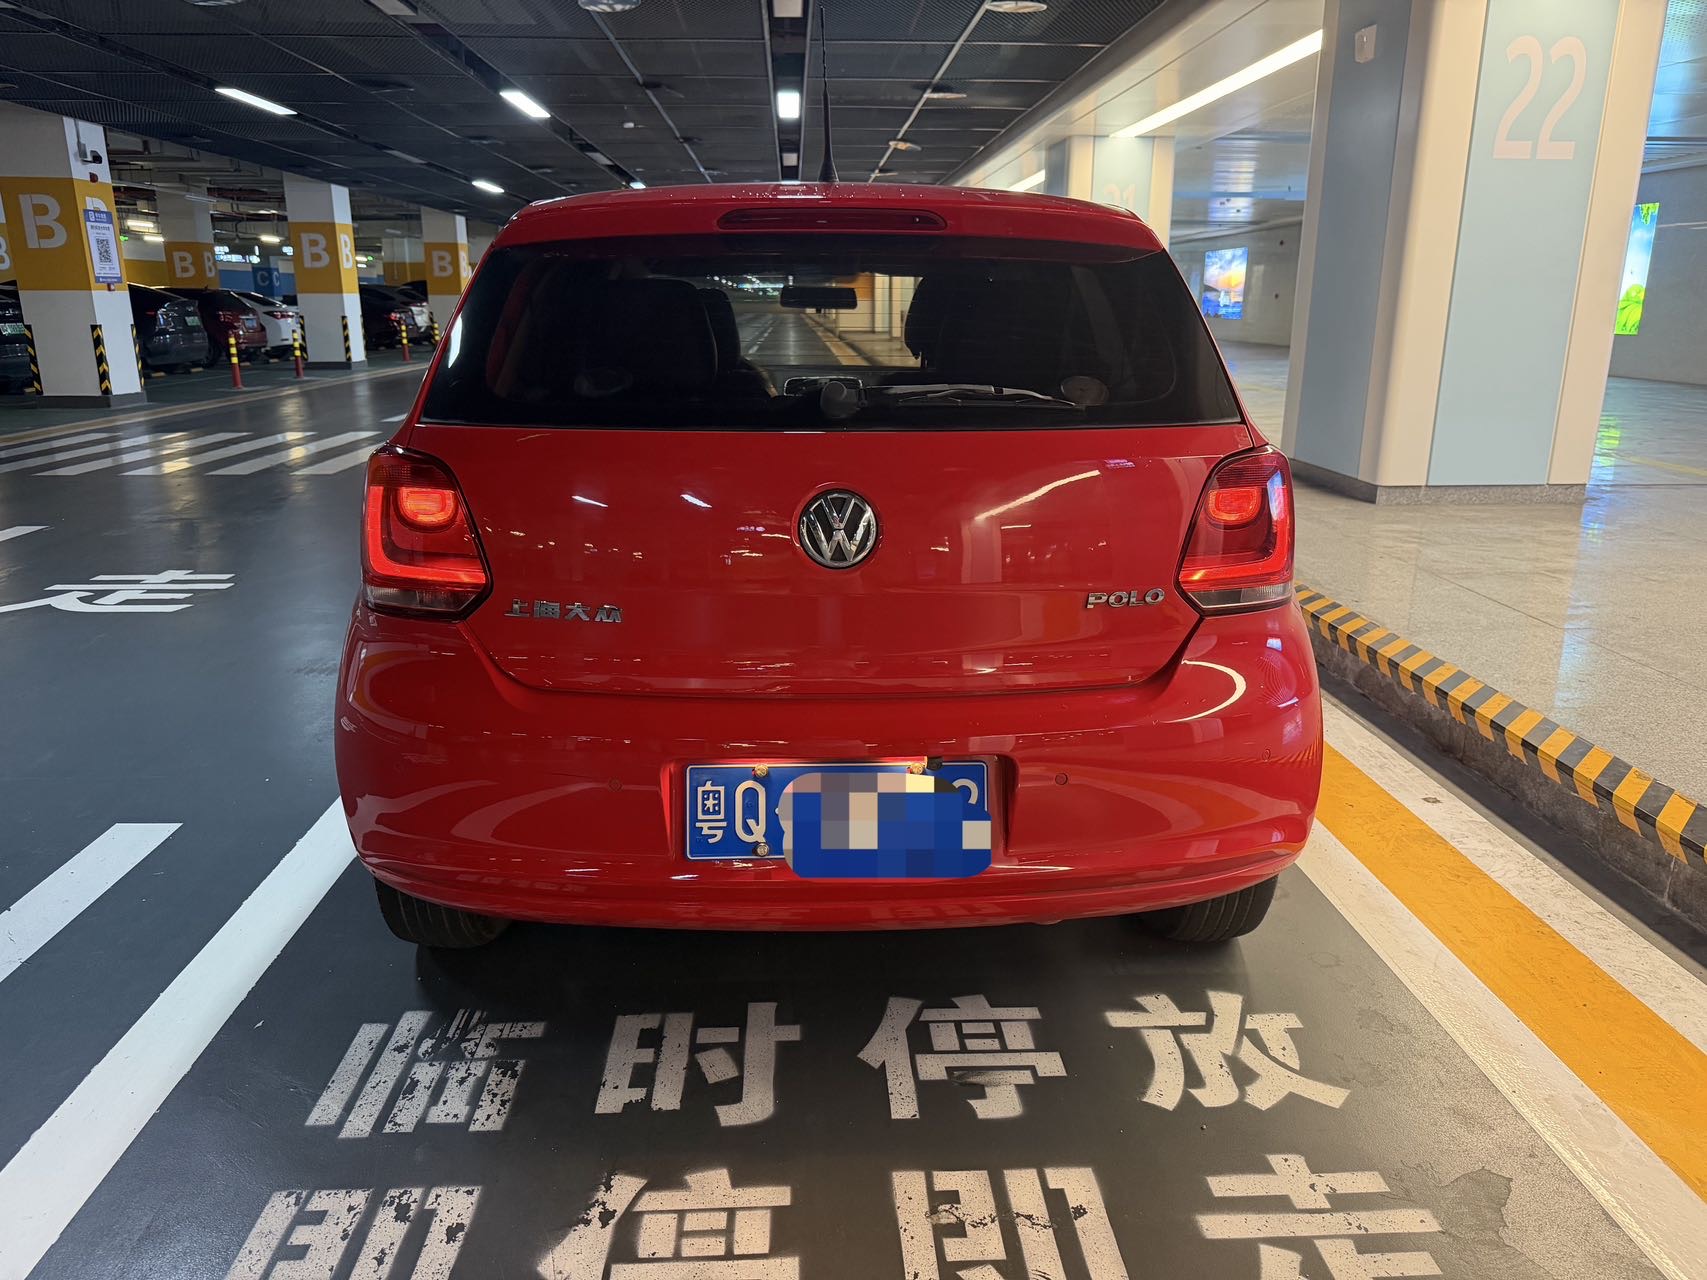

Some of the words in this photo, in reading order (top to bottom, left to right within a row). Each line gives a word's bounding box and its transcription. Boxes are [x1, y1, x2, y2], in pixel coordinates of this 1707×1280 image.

[1493, 35, 1588, 160] 22
[19, 194, 67, 248] B
[172, 251, 196, 278] B
[203, 251, 216, 278] B
[301, 233, 330, 269] B
[340, 233, 353, 269] B
[431, 250, 453, 277] B
[257, 271, 270, 286] C
[272, 271, 280, 287] C
[0, 569, 236, 613] 走
[1086, 587, 1165, 609] POLO
[504, 598, 624, 623] 上海大众
[304, 990, 1351, 1139] 临时停放
